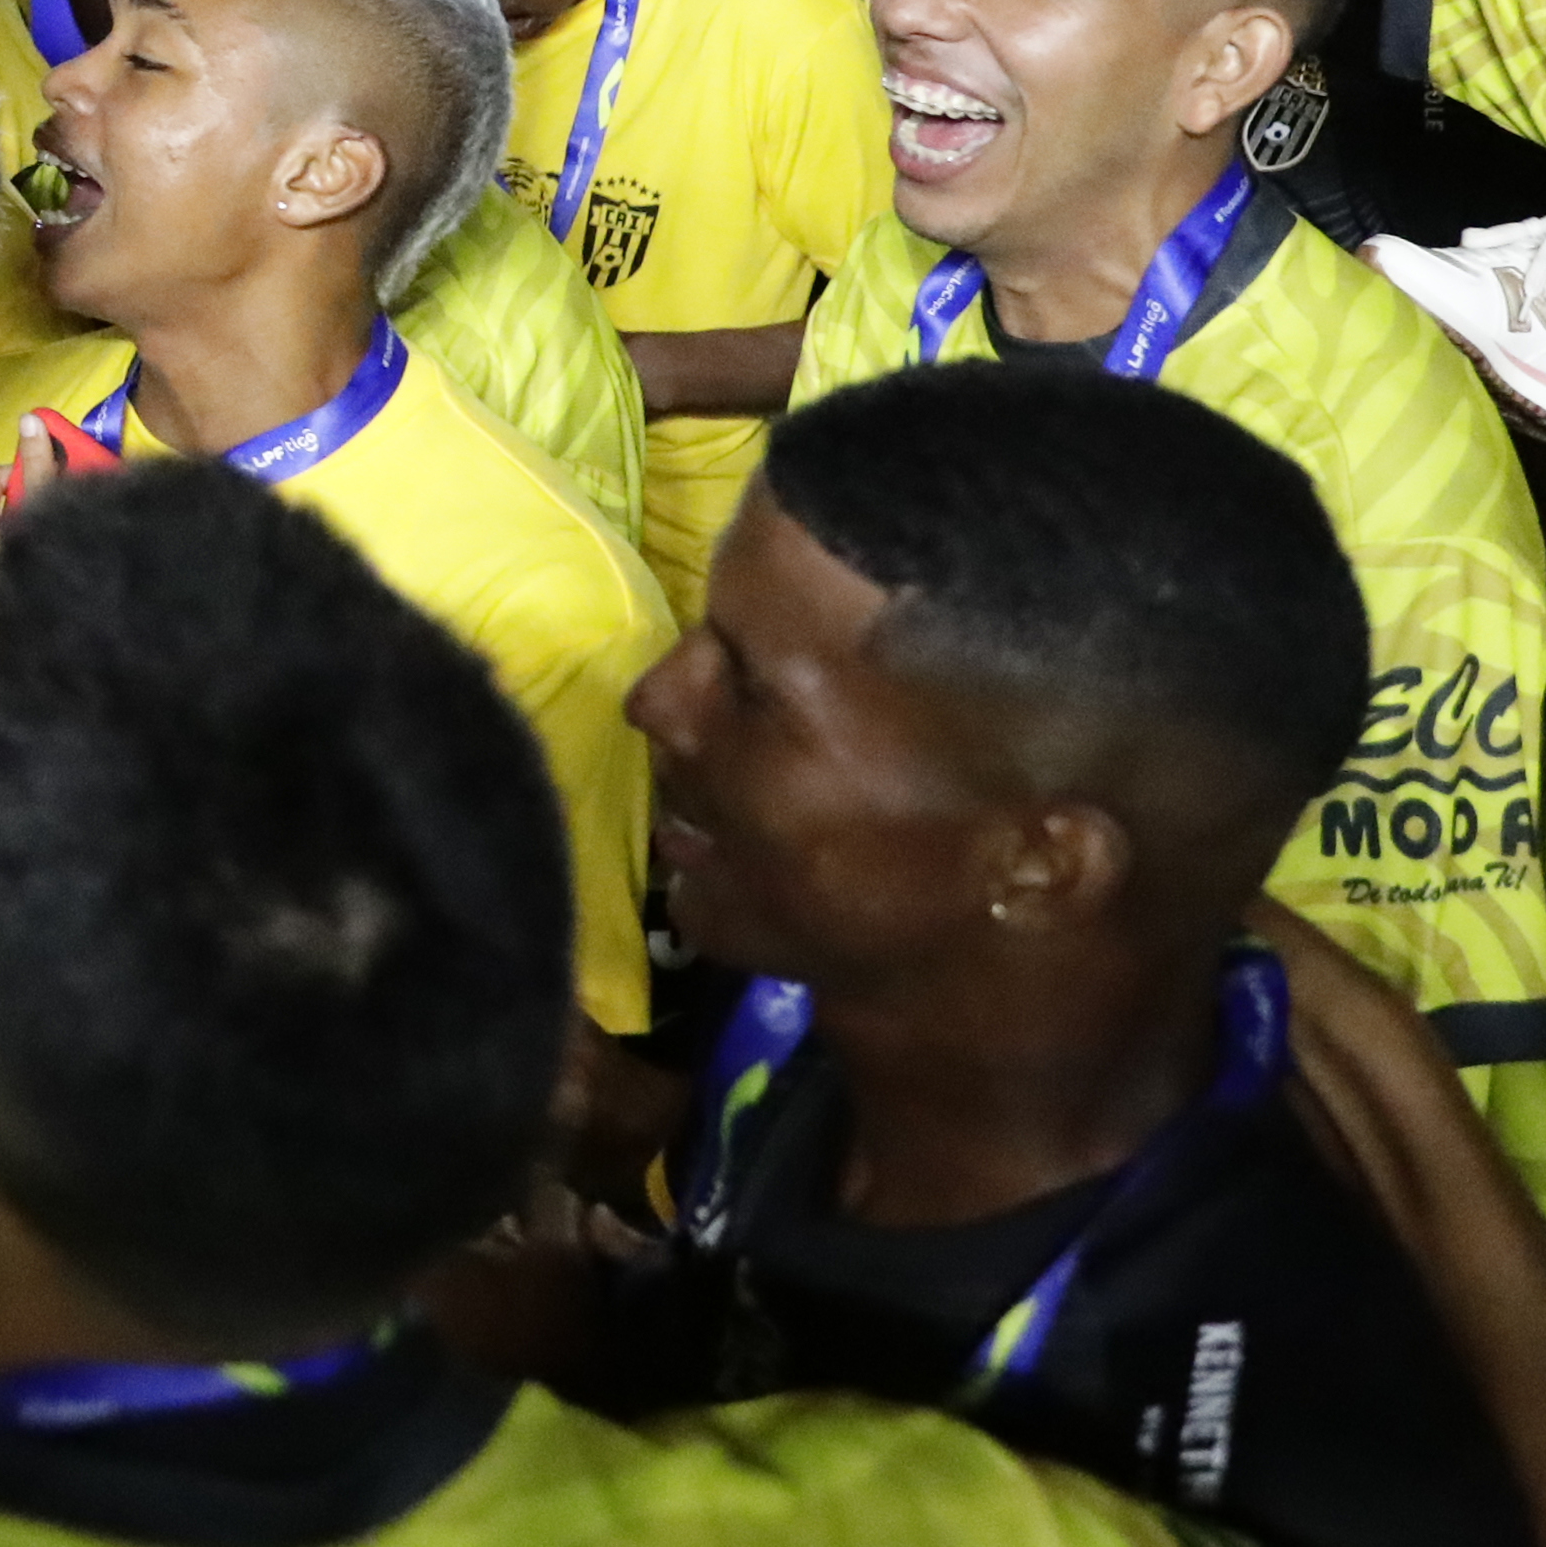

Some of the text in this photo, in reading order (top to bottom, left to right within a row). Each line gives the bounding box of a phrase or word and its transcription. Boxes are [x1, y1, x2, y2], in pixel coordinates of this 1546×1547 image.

[605, 209, 640, 230] CAI
[1126, 331, 1151, 370] LPF
[252, 428, 319, 469] LPF tigo
[1320, 795, 1540, 860] MODA
[1342, 877, 1380, 904] De
[1387, 880, 1441, 903] todo
[1443, 875, 1486, 896] ara
